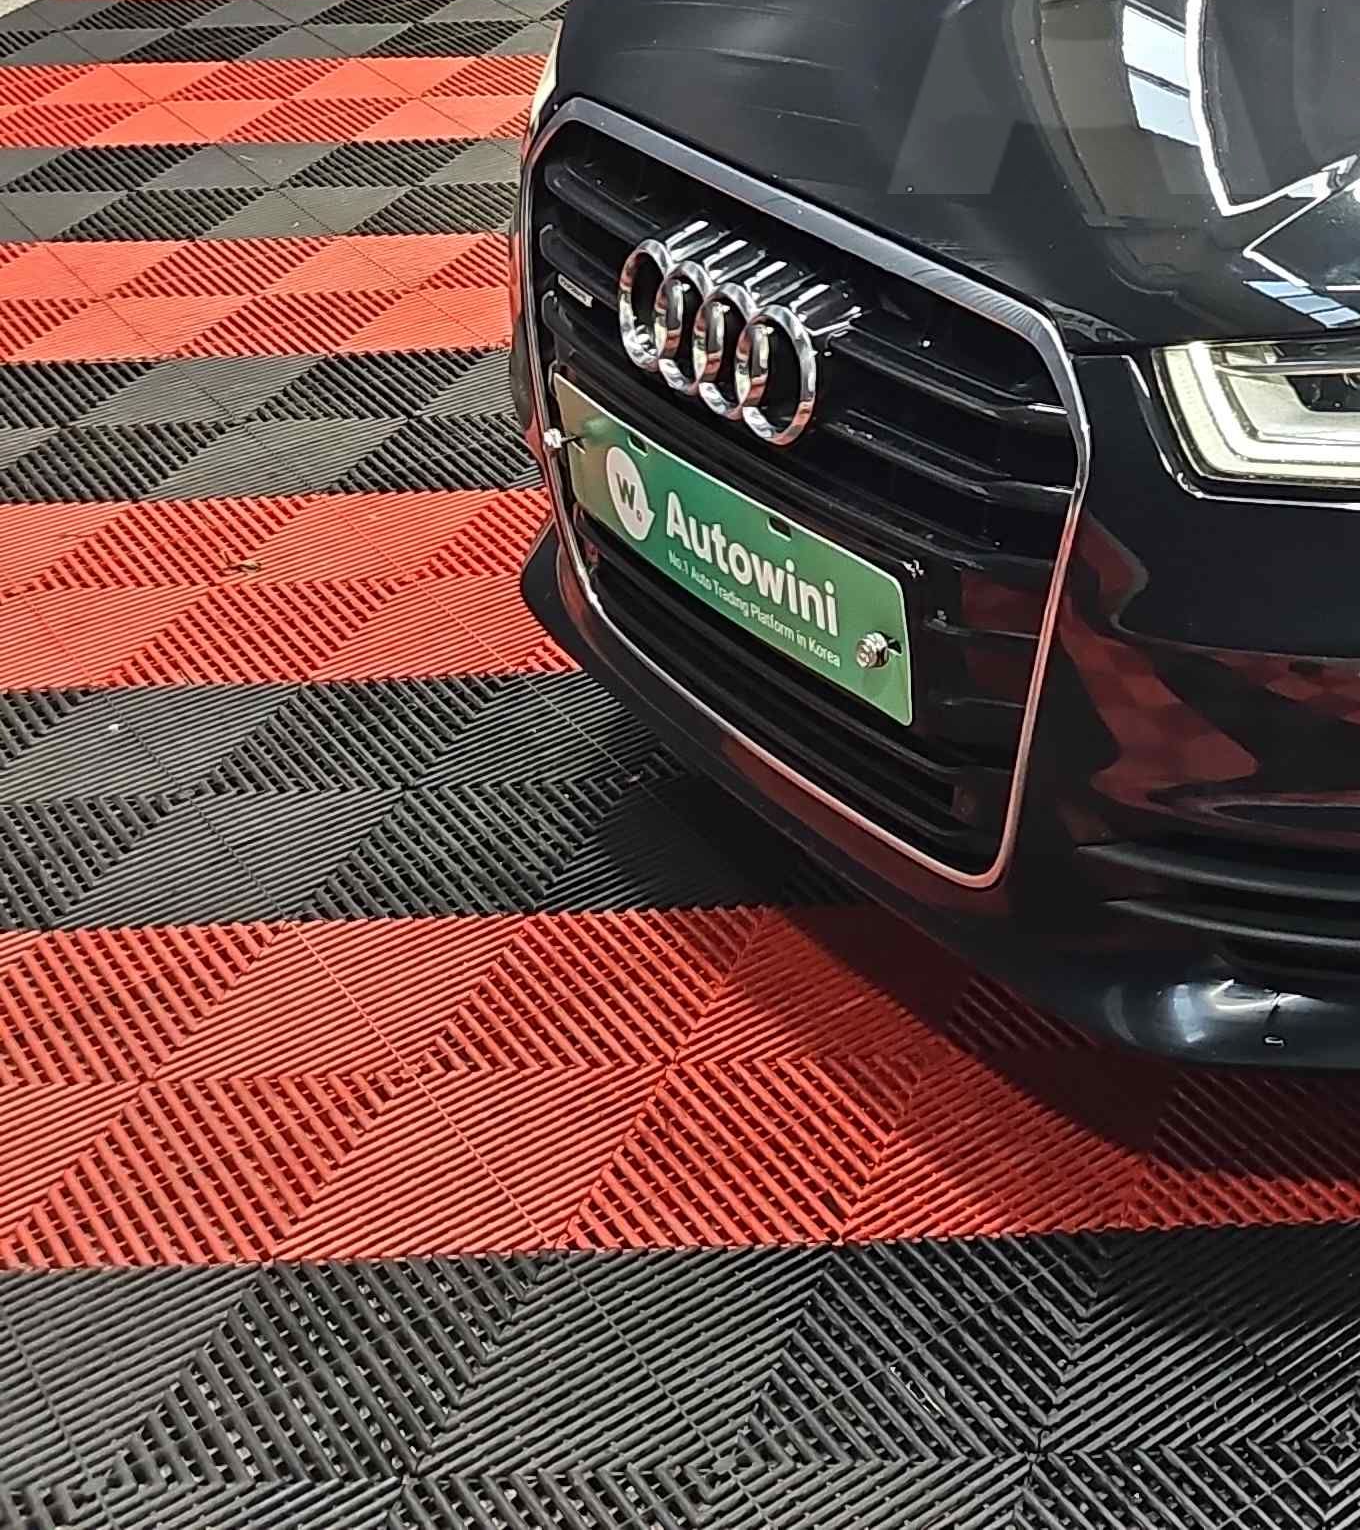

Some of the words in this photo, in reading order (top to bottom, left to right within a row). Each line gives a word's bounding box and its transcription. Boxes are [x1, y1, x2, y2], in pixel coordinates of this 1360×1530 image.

[665, 491, 839, 638] Autowini
[713, 579, 750, 618] Trading
[750, 602, 795, 642] Platform
[796, 629, 808, 648] in
[808, 636, 841, 669] Korea
